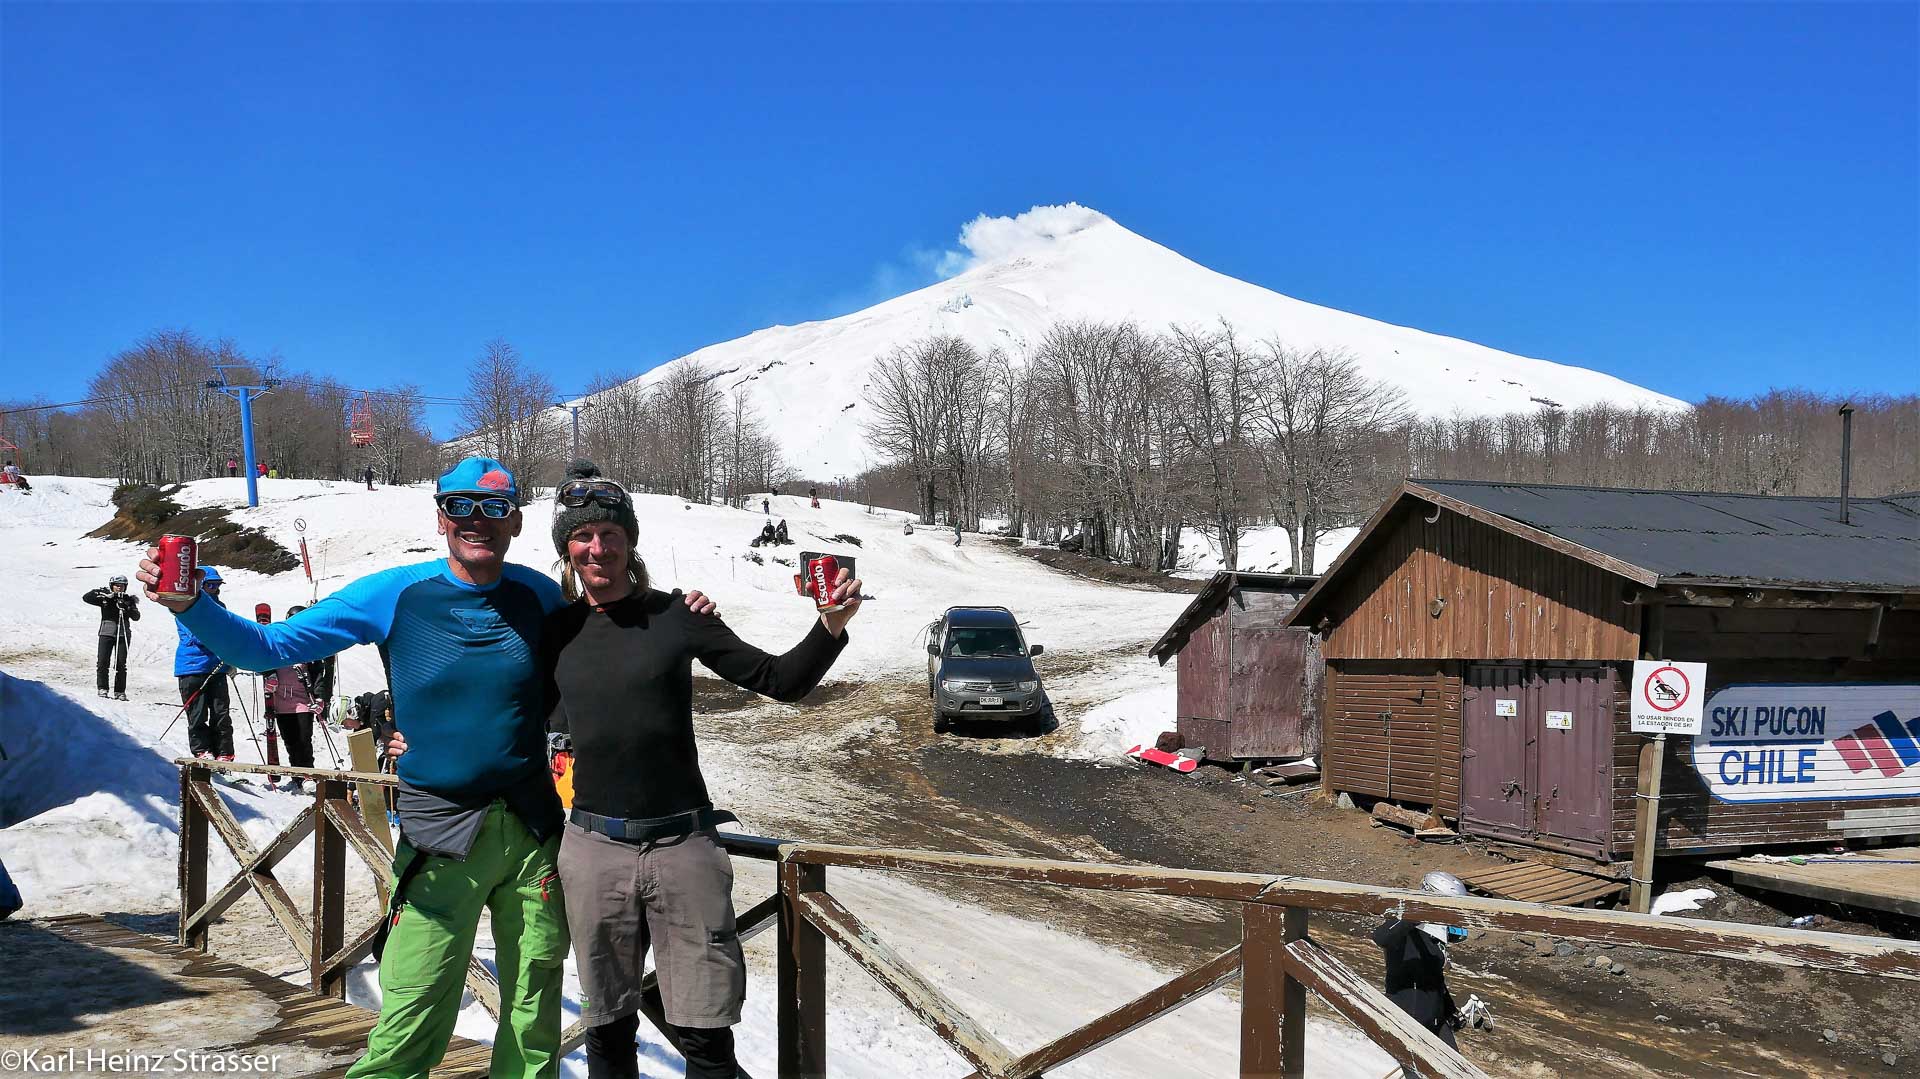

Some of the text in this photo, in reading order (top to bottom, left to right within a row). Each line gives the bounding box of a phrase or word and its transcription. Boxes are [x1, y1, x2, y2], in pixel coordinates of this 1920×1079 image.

[174, 545, 191, 592] Escudo
[815, 565, 829, 606] Escudo
[1711, 706, 1826, 736] SKI PUCON
[1719, 749, 1817, 785] CHILE
